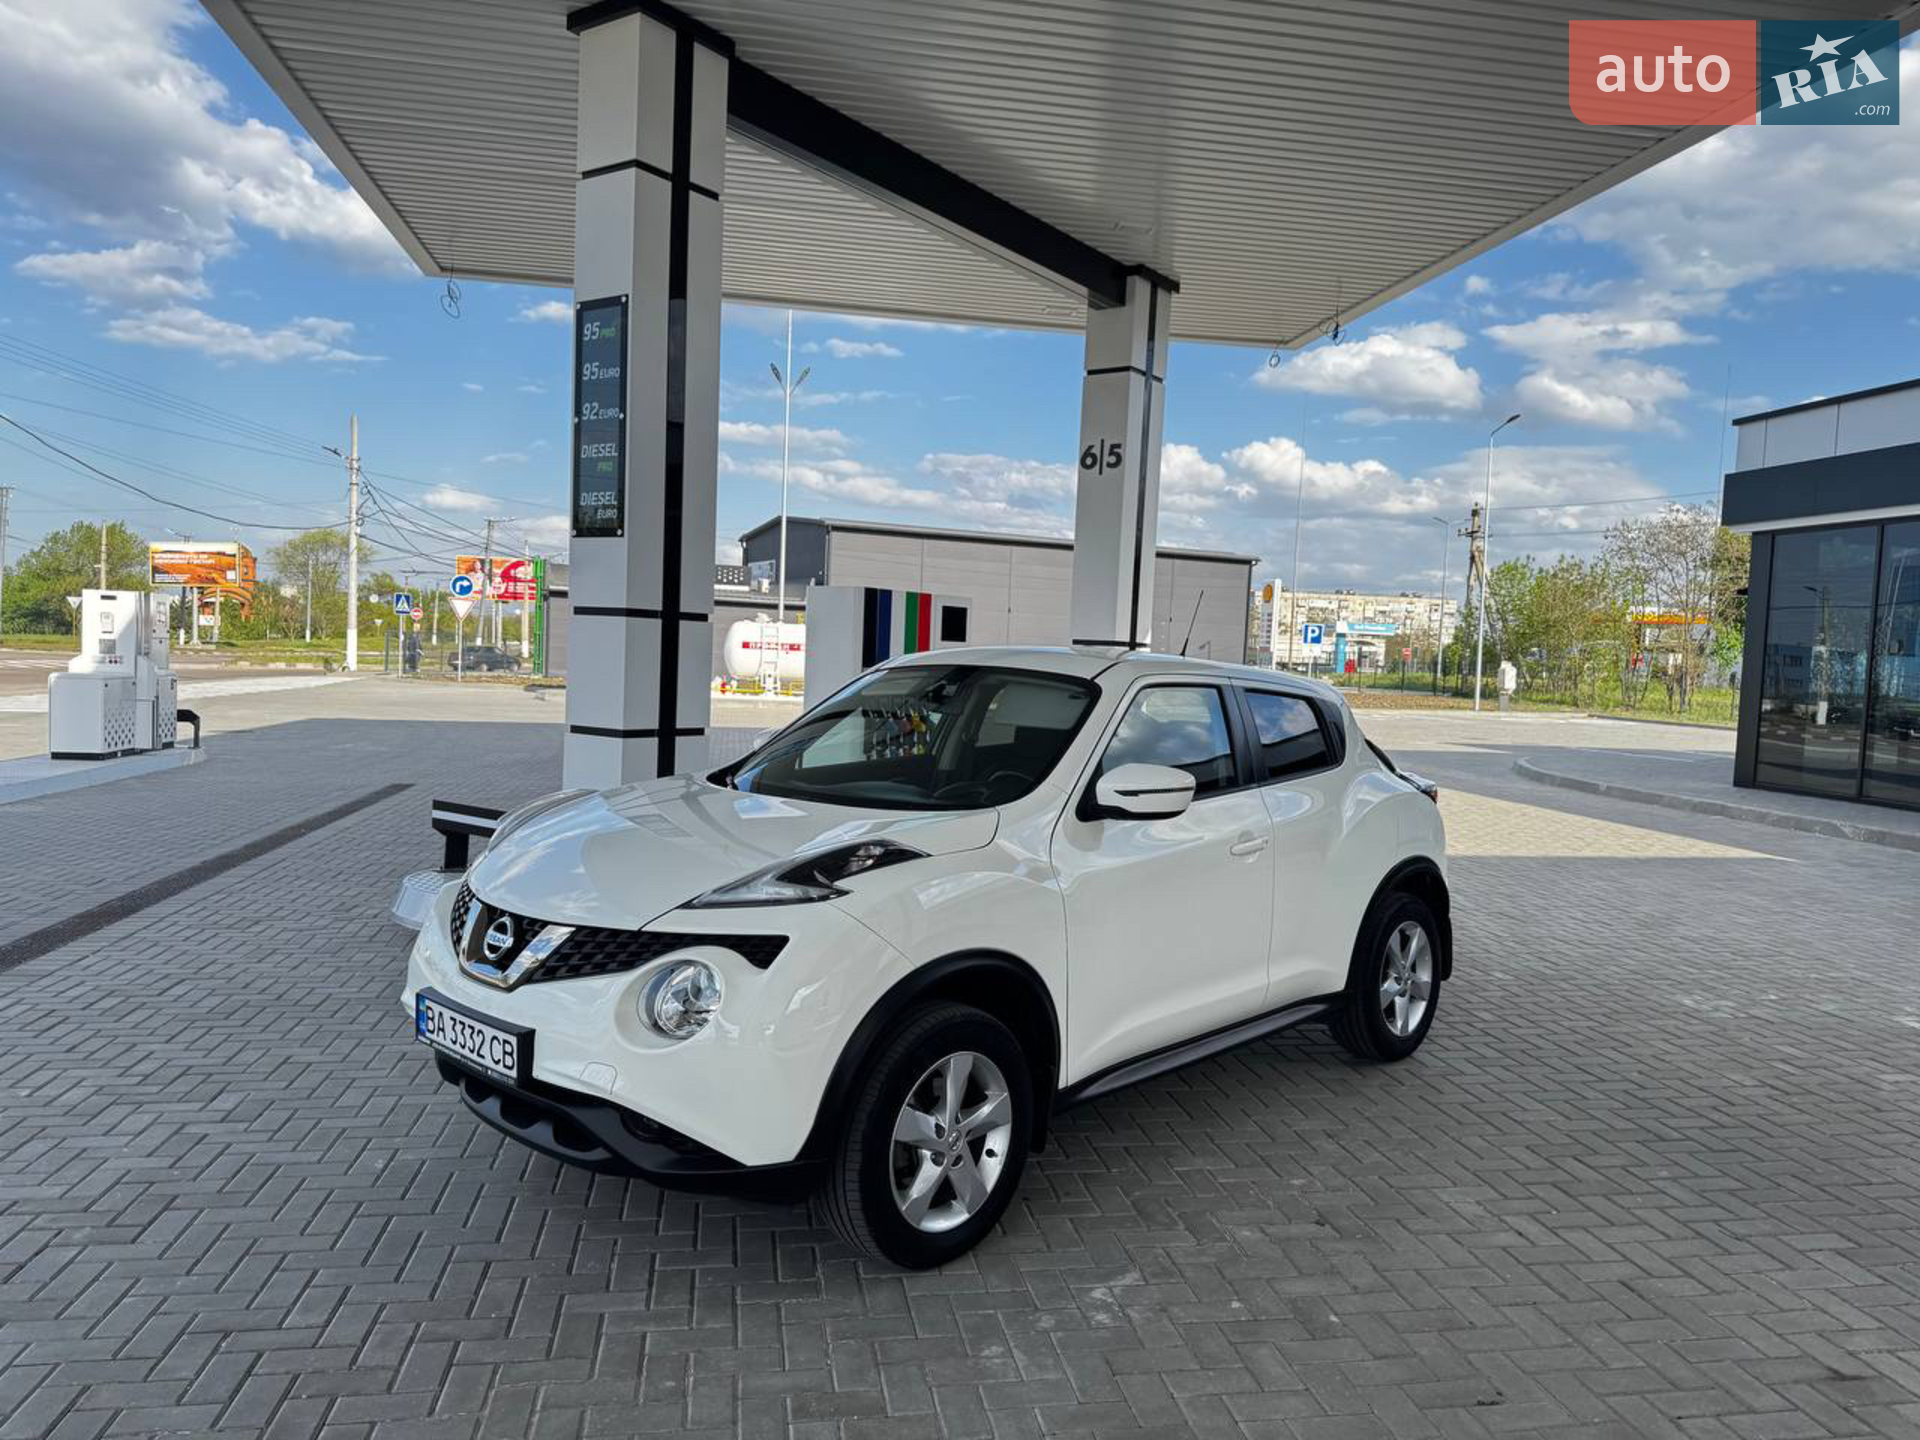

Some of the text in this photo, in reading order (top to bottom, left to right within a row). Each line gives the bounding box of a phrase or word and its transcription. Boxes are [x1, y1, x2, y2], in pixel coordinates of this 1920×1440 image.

[583, 321, 601, 341] 95
[582, 362, 620, 380] 95 EURO
[581, 402, 619, 420] 92 EURO
[580, 443, 619, 458] DIESEL
[580, 491, 618, 506] DIESEL
[597, 508, 618, 519] EURO
[1308, 626, 1319, 643] P
[425, 1004, 447, 1041] BA
[449, 1016, 486, 1060] 3332
[489, 1035, 515, 1071] CB
